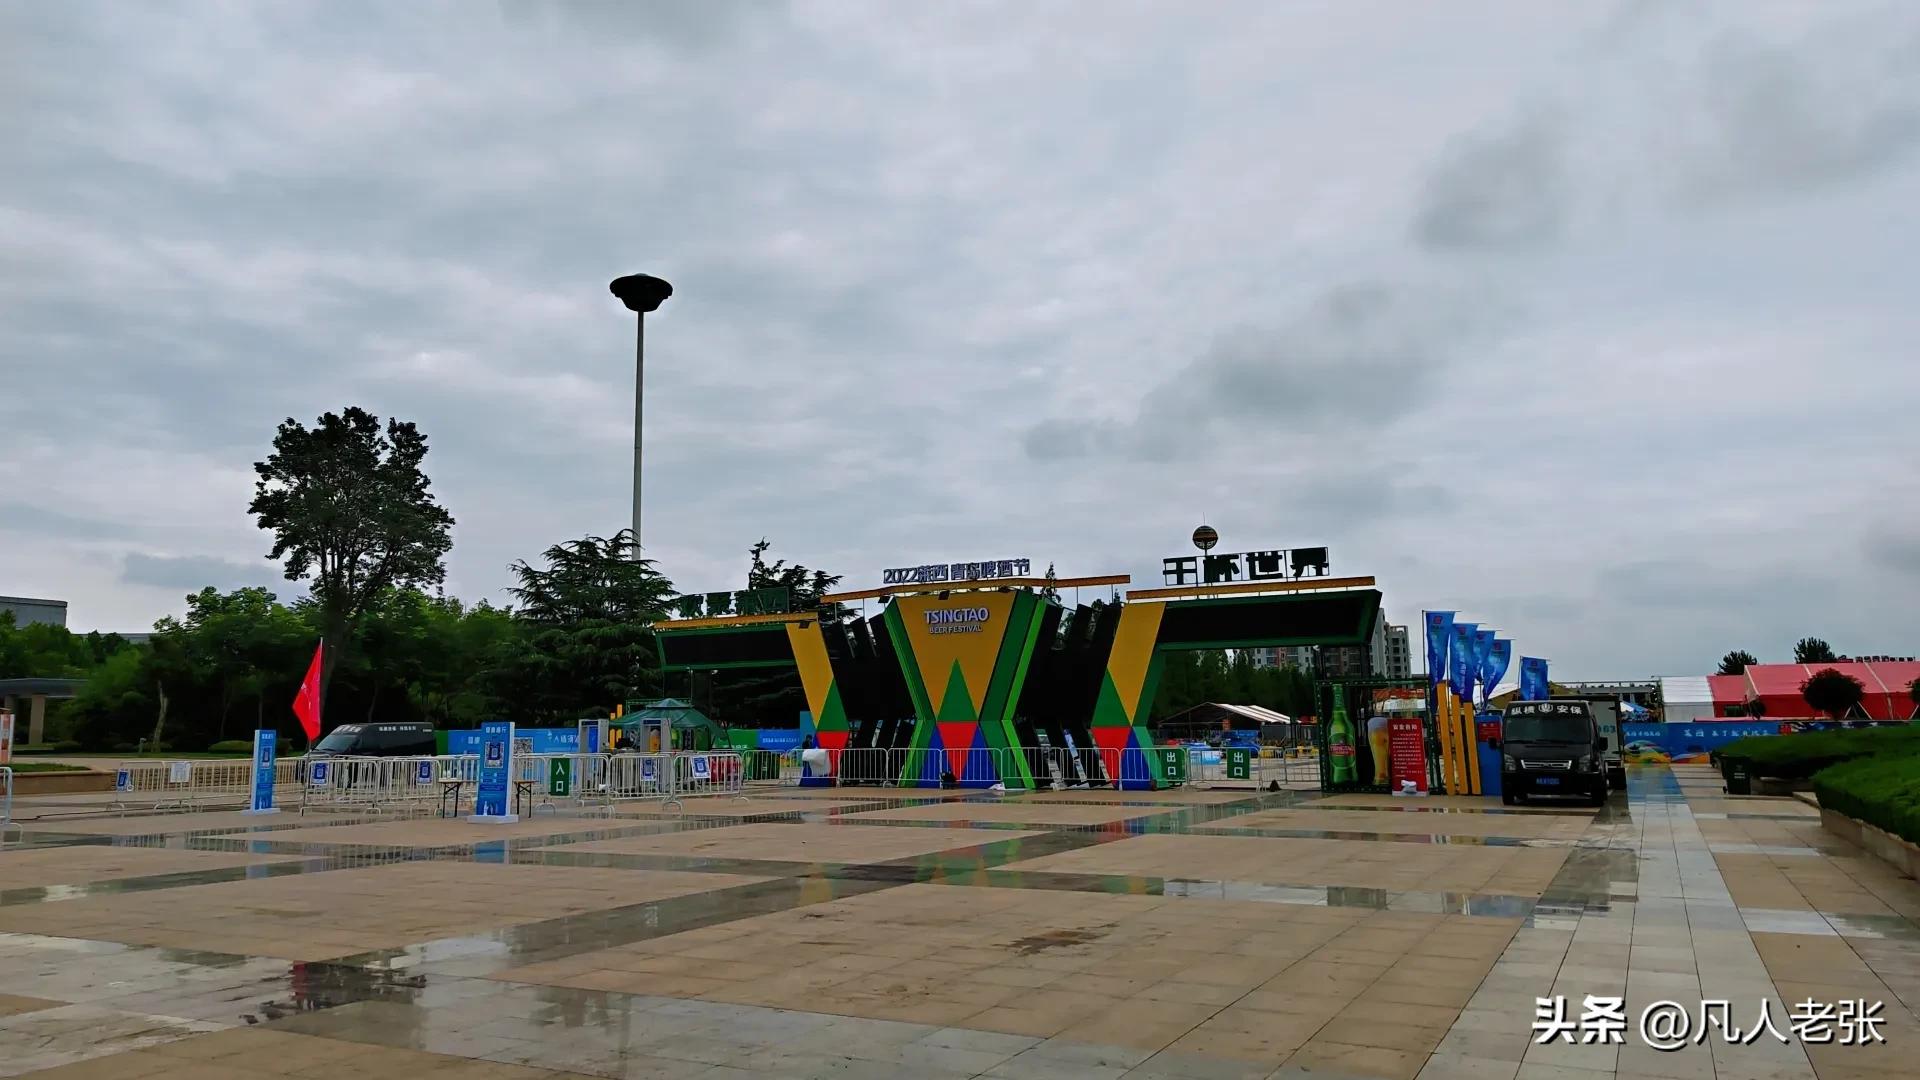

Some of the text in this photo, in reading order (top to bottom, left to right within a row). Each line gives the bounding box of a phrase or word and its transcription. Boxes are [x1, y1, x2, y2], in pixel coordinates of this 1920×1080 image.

[924, 607, 989, 624] TSINGTAO
[948, 625, 982, 633] FESTIVAL
[1166, 751, 1176, 775] 出口
[1233, 752, 1244, 776] 出口
[555, 762, 565, 792] 入口
